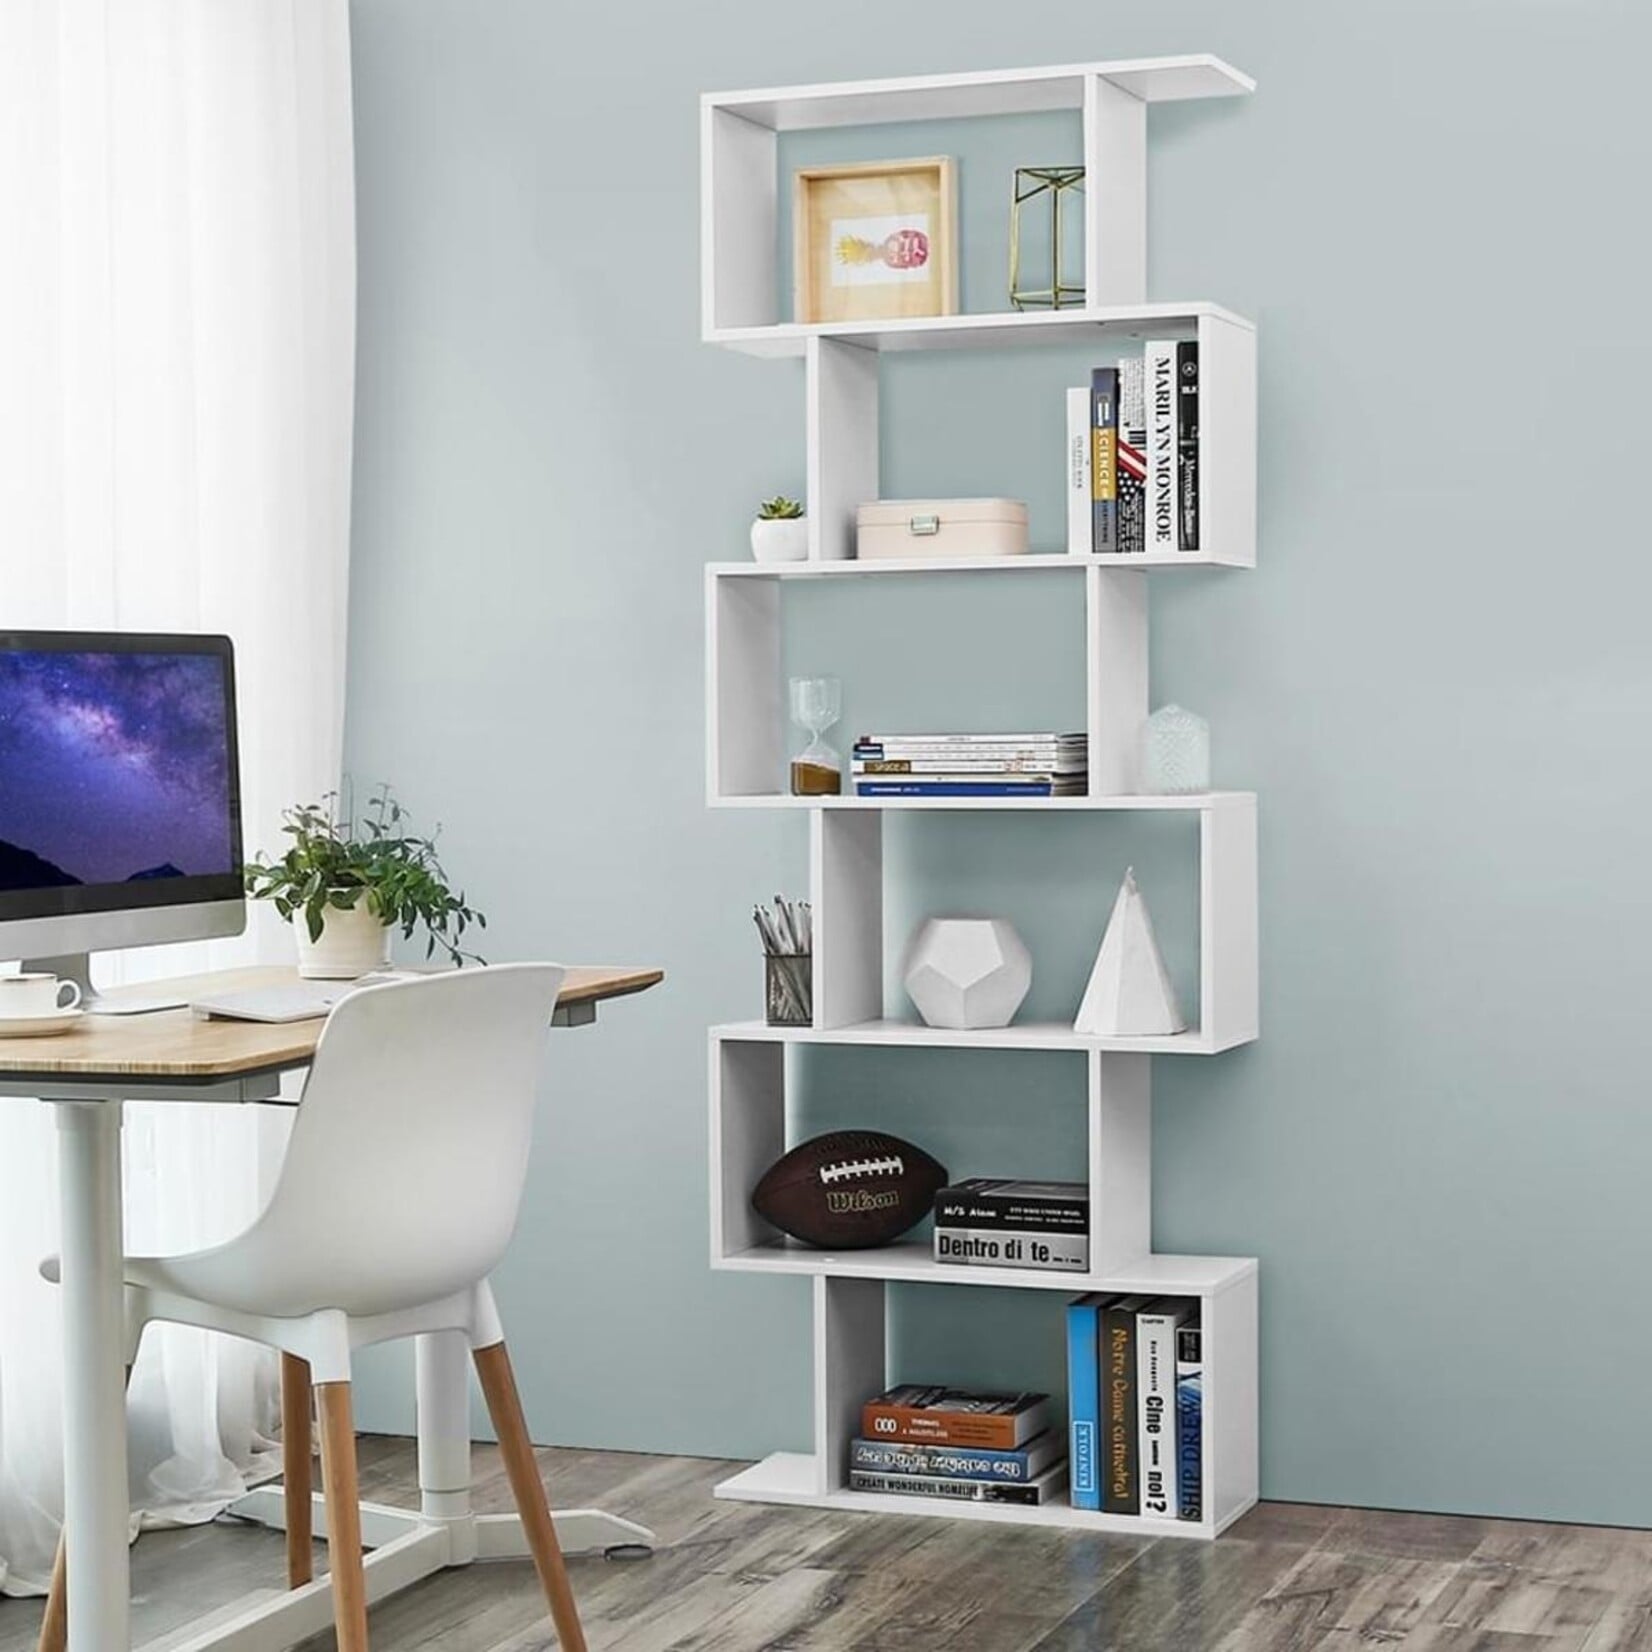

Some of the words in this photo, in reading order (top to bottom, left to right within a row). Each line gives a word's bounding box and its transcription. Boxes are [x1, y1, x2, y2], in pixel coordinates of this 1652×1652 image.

[1155, 357, 1171, 451] MARILYN
[1098, 428, 1110, 486] SCIENCE
[1155, 455, 1172, 543] MONROE
[826, 1189, 899, 1213] Wilson
[939, 1235, 1000, 1259] Dentro
[1005, 1239, 1022, 1260] di
[1031, 1241, 1049, 1262] te
[1145, 1396, 1164, 1434] Cine
[1078, 1428, 1088, 1487] KINFOLK
